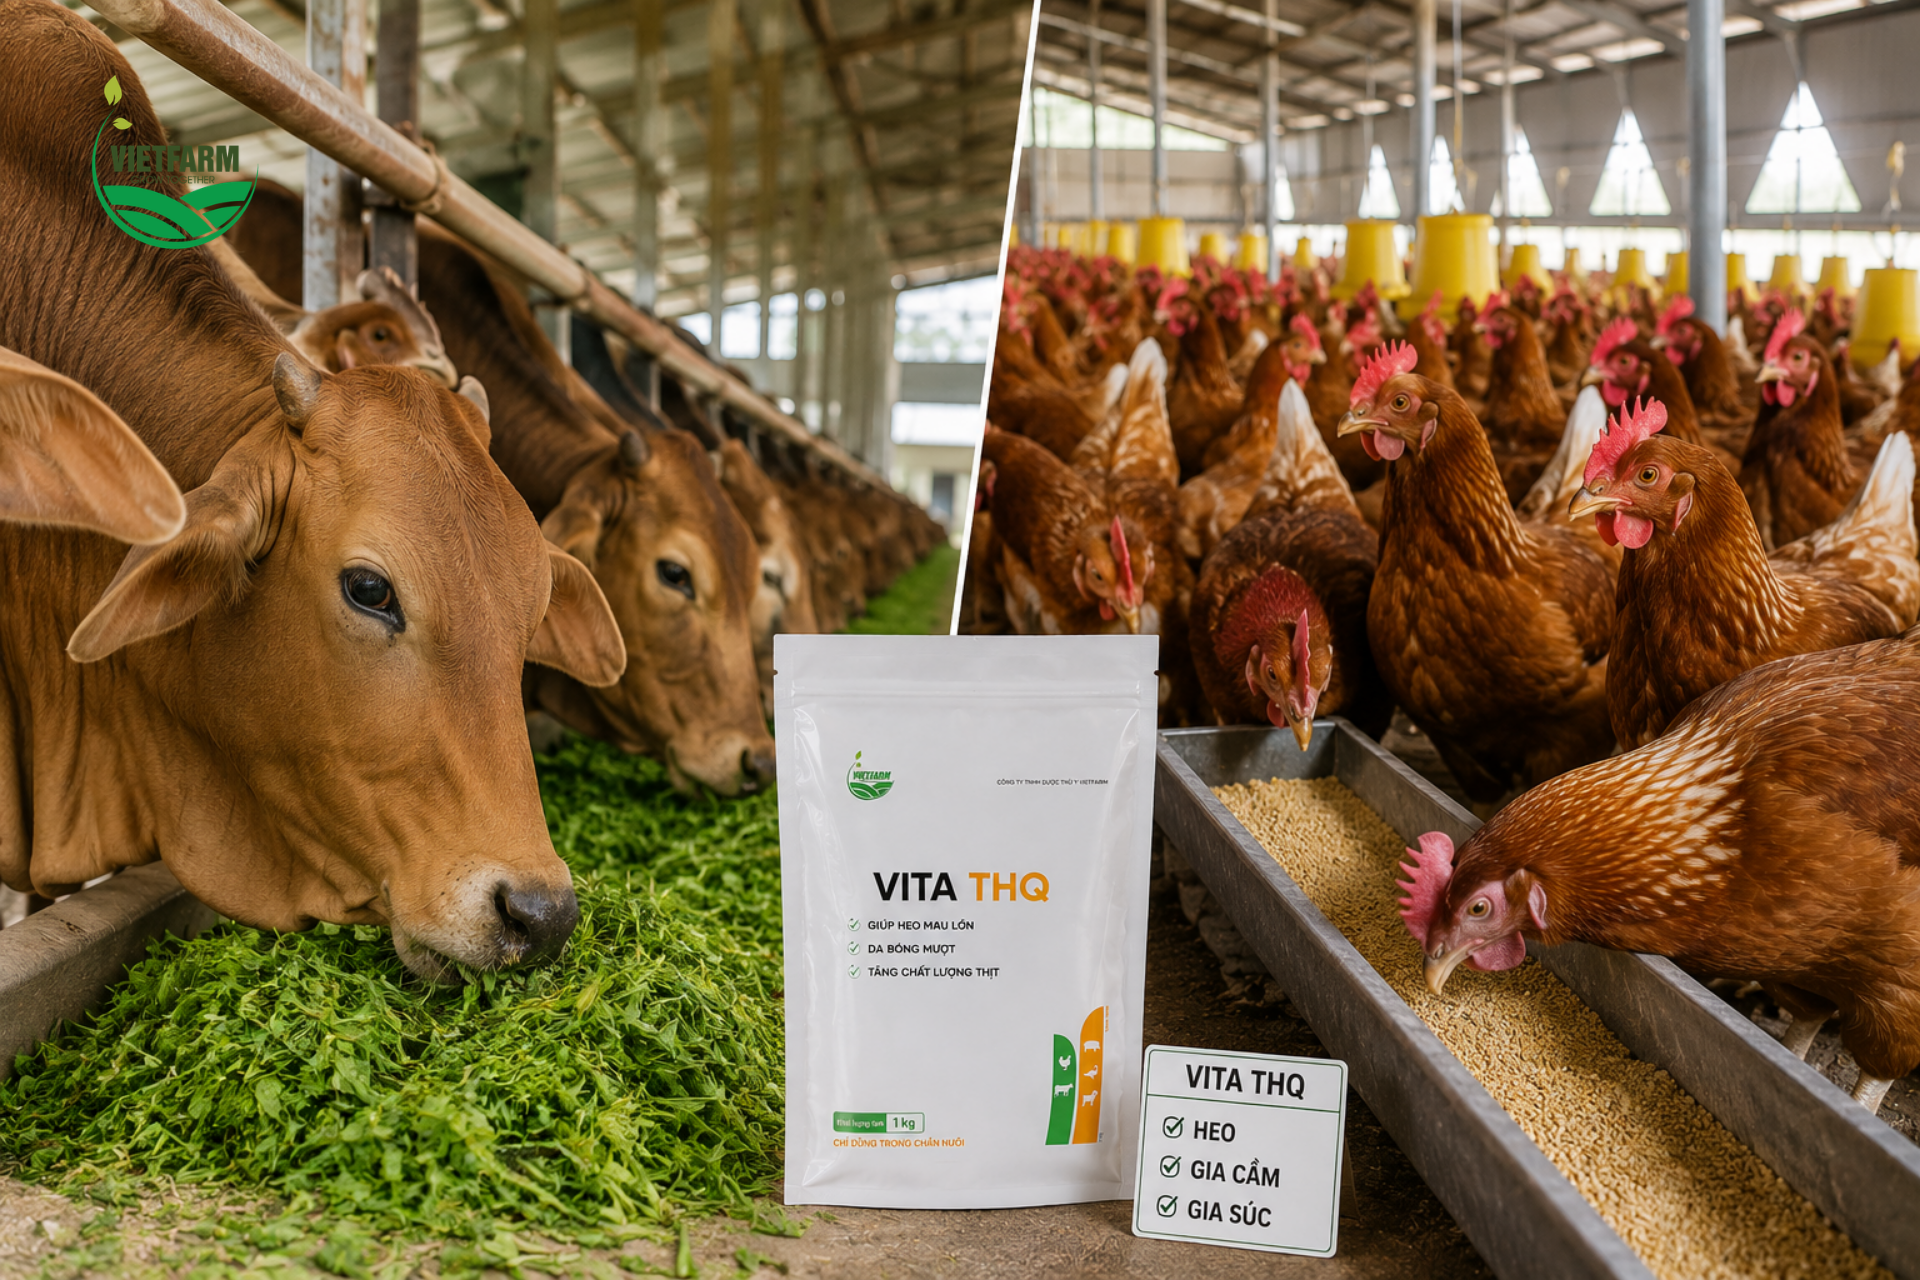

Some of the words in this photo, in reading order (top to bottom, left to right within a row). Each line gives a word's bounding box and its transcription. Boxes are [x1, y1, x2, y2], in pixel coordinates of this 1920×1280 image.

[873, 872, 958, 901] VITA
[968, 872, 1050, 903] THQ
[898, 920, 921, 931] HEO
[923, 920, 949, 931] MAU
[868, 944, 884, 954] DA
[887, 942, 920, 954] BÓNG
[975, 967, 1000, 980] THỊT
[1186, 1064, 1243, 1093] VITA
[1251, 1070, 1306, 1100] THQ
[893, 1117, 899, 1128] 1
[901, 1117, 916, 1130] kg
[1193, 1120, 1236, 1143] HEO
[880, 1139, 912, 1148] TRONG
[1190, 1160, 1226, 1182] GIA
[1232, 1158, 1280, 1188] CẦM
[1187, 1200, 1223, 1222] GIA
[1229, 1200, 1272, 1228] SÚC
